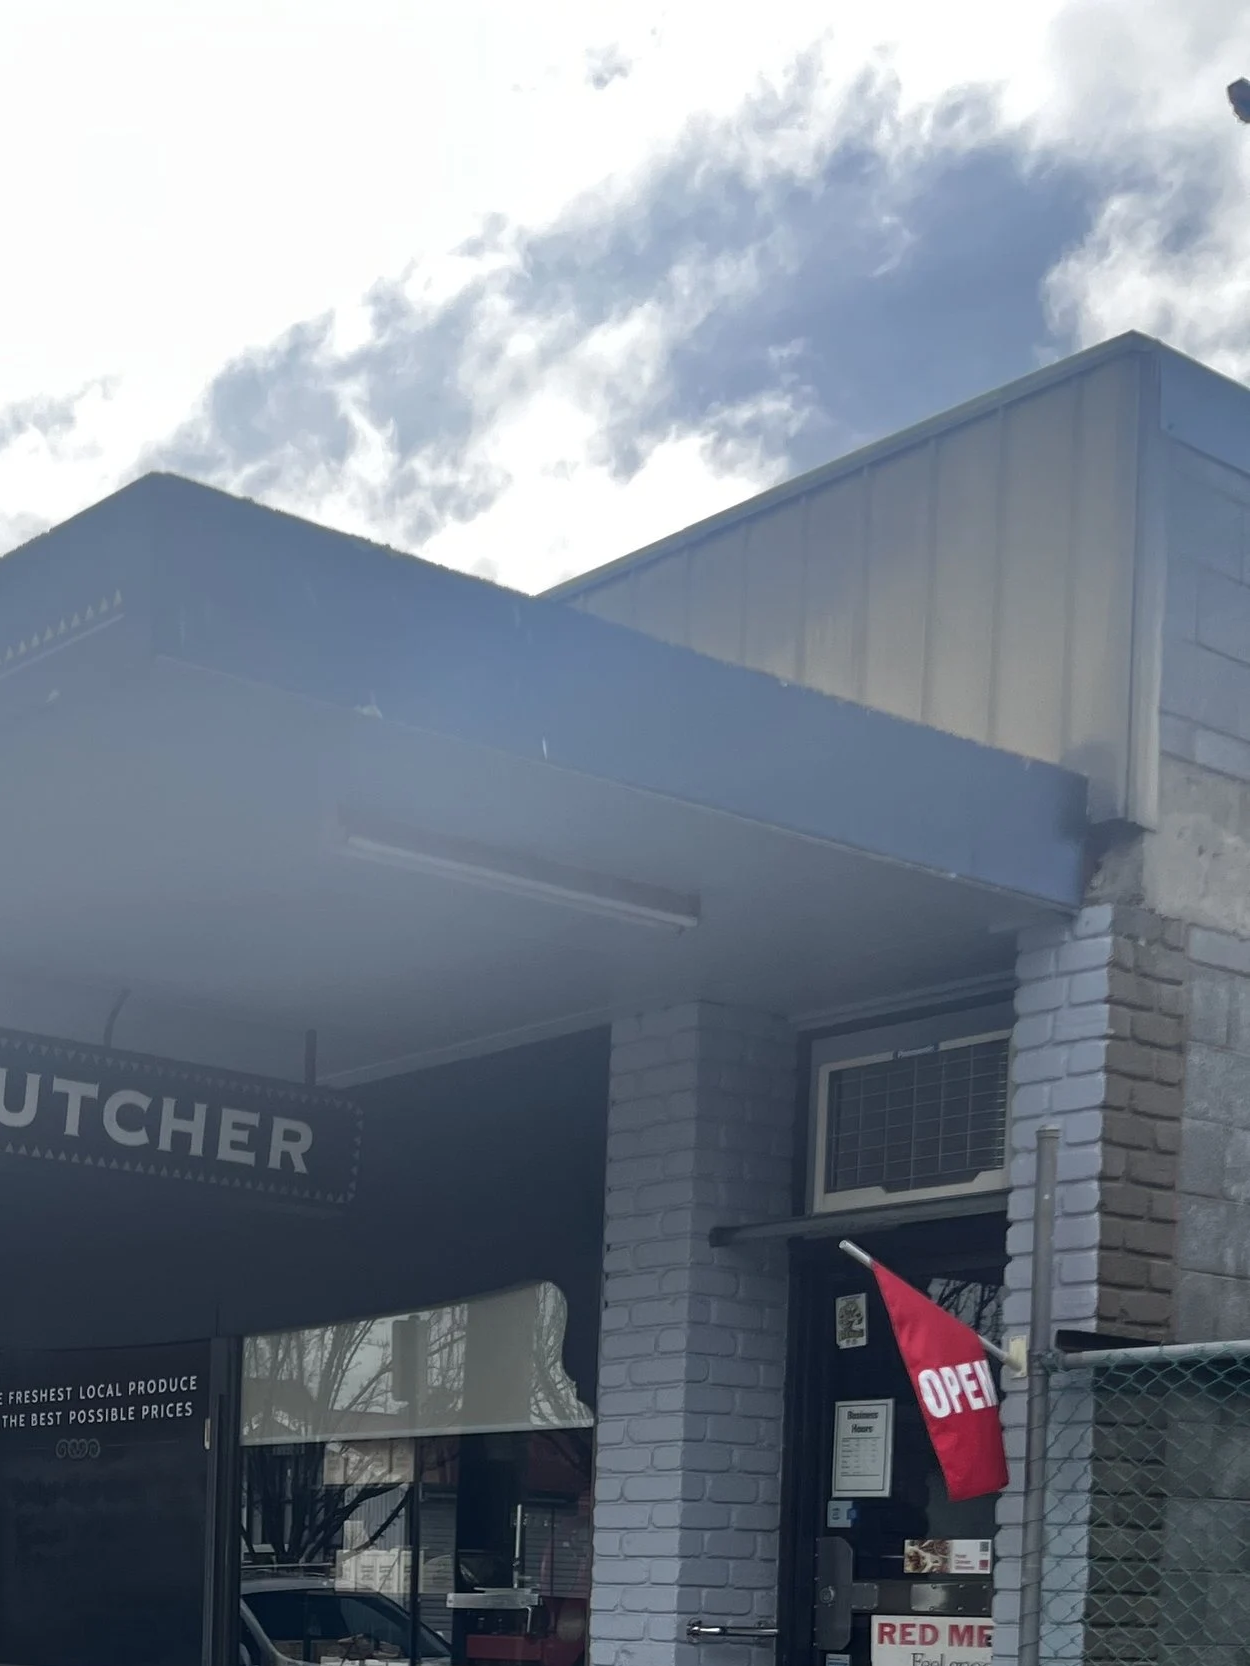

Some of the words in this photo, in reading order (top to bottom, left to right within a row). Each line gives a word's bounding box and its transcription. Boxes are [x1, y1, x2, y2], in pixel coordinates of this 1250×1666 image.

[8, 1387, 73, 1406] FRESHEST
[79, 1382, 123, 1400] LOCAL
[128, 1375, 198, 1396] PRODUCE
[918, 1359, 999, 1419] OPEN
[2, 1414, 25, 1429] THE
[31, 1411, 62, 1427] BEST
[68, 1406, 135, 1425] POSSIBLE
[141, 1401, 193, 1420] PRICES
[877, 1622, 939, 1646] RED
